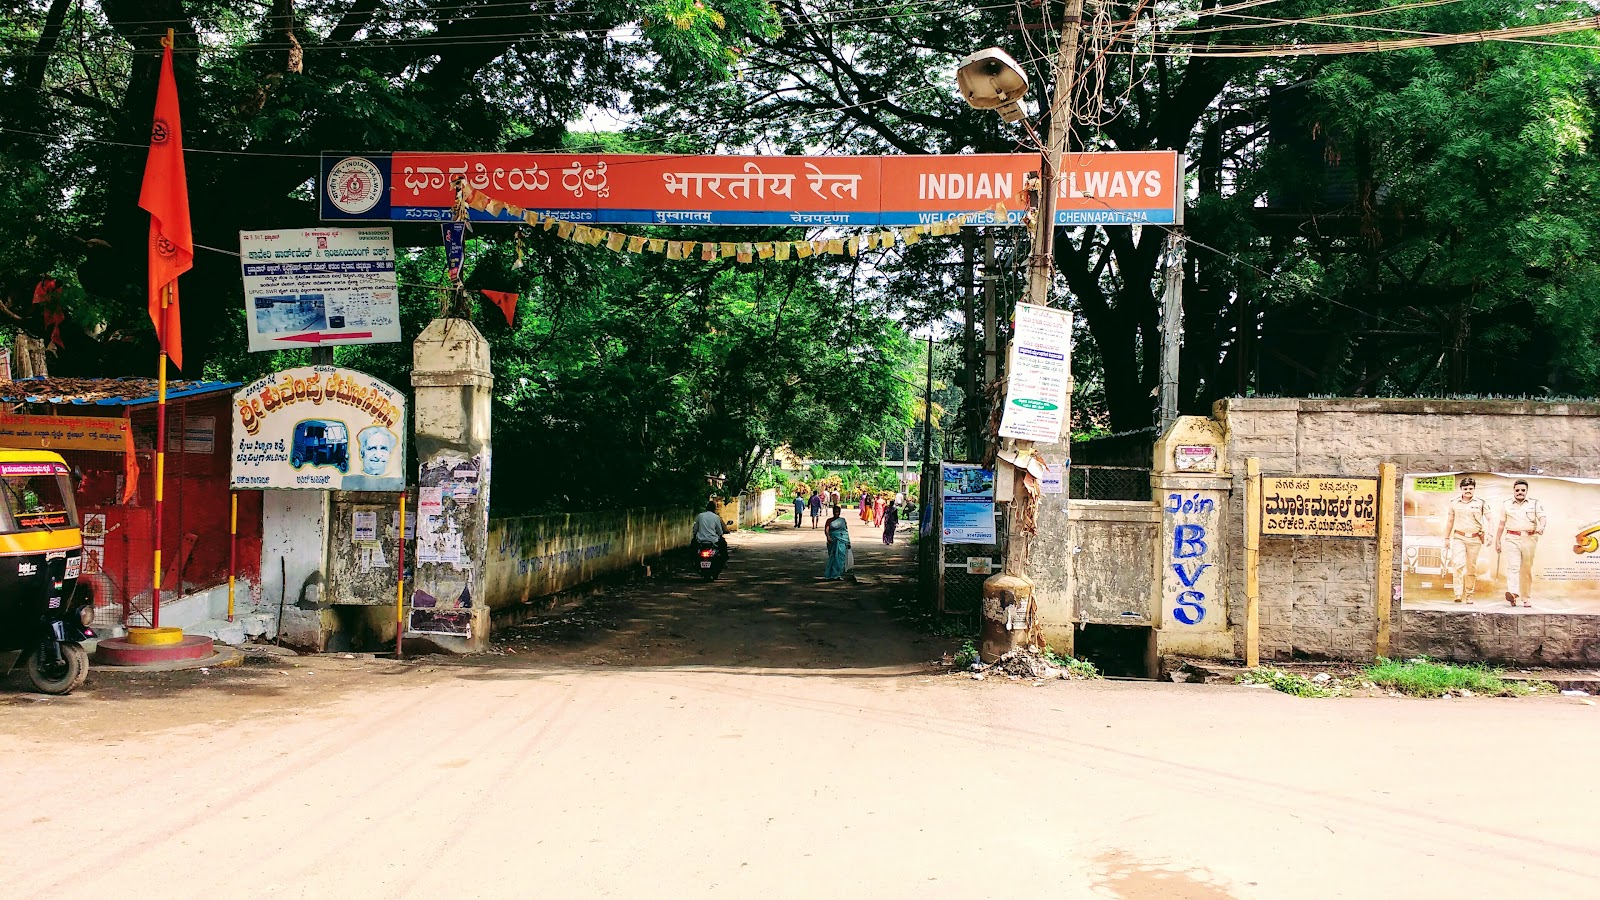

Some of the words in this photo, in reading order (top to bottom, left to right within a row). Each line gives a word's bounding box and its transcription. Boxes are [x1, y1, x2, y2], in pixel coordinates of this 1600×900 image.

[345, 161, 369, 170] INDIAN
[662, 162, 797, 200] भारतीय
[804, 162, 863, 200] रेल
[919, 172, 1013, 200] INDIAN
[1059, 212, 1148, 223] CHENNAPATTANA
[237, 398, 266, 436] ಶ್ರೀ
[259, 372, 325, 414] ಕುವೆಂಪು
[1165, 493, 1214, 514] Join
[1354, 494, 1375, 522] ರಸ್ತೆ
